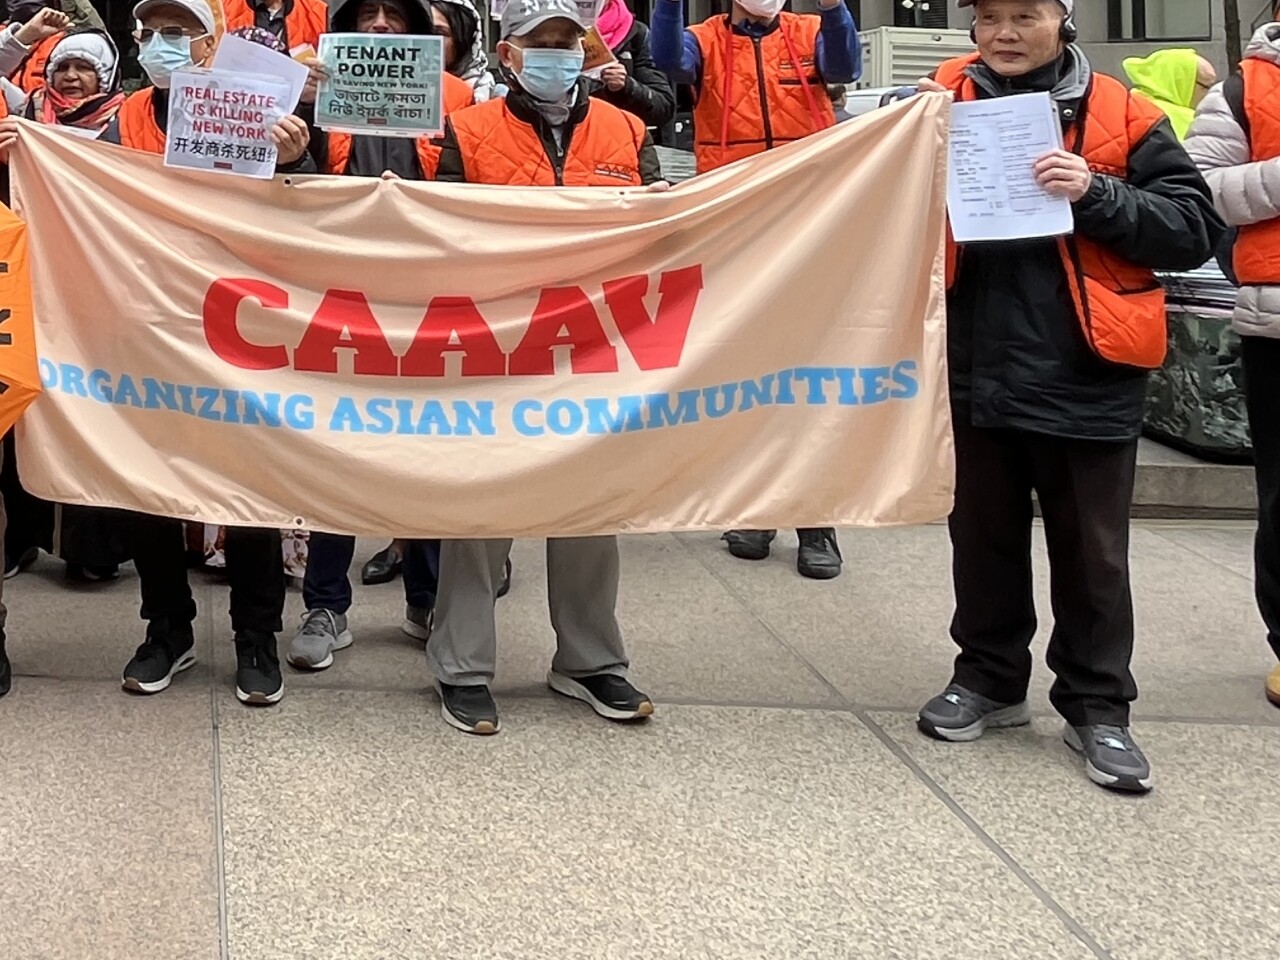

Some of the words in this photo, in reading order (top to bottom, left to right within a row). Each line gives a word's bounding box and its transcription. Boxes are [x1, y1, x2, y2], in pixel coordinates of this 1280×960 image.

[334, 46, 421, 61] TENANT
[338, 63, 415, 79] POWER
[343, 79, 375, 87] SAVING
[377, 81, 397, 89] NEW
[184, 87, 219, 101] REAL
[223, 91, 276, 108] ESTATE
[192, 104, 205, 116] IS
[209, 105, 264, 123] KILLING
[192, 121, 224, 135] NEW
[228, 125, 266, 140] YORK
[203, 264, 704, 378] CAAAV
[39, 358, 314, 430] ORGANIZING
[329, 396, 496, 436] ASIAN
[511, 360, 919, 437] COMMUNITIES
